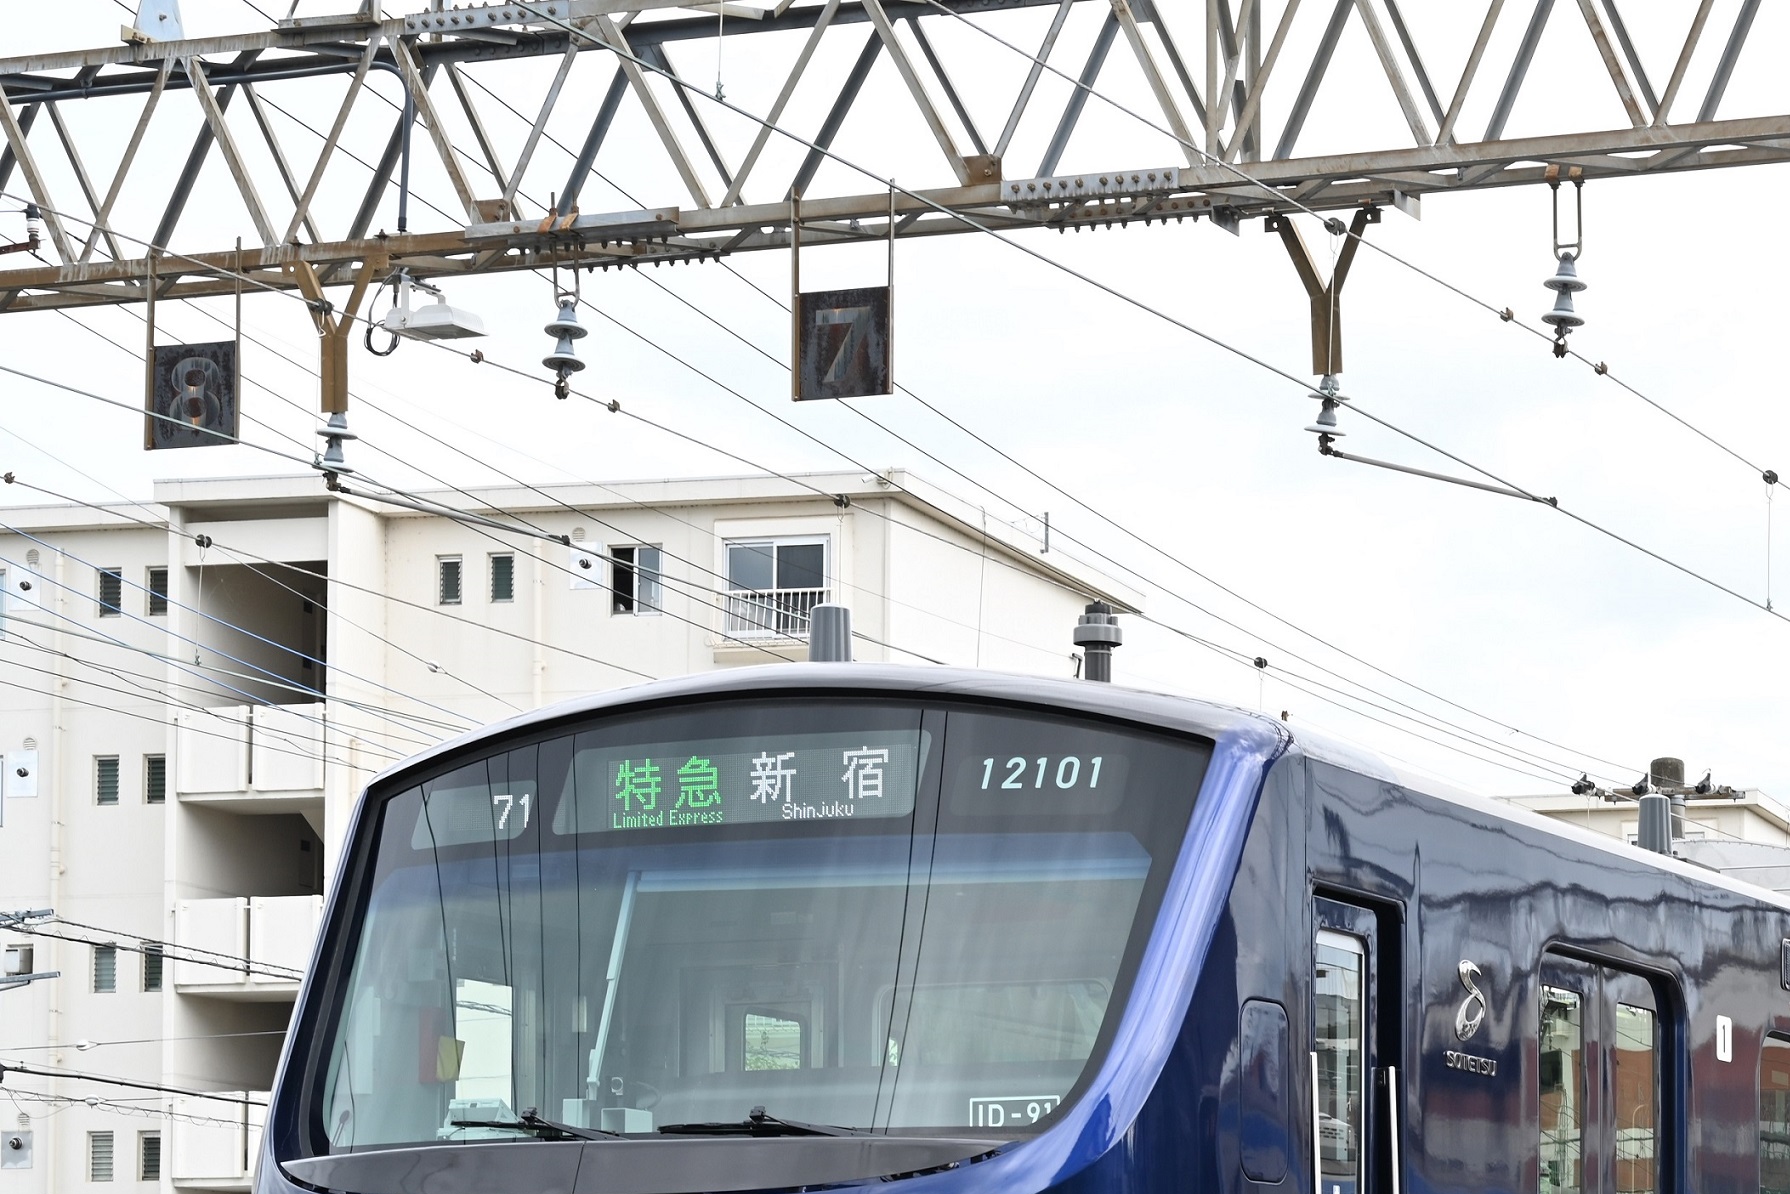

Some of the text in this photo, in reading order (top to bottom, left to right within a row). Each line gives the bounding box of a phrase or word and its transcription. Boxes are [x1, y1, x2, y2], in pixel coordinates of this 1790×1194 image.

[815, 306, 871, 382] 7
[170, 357, 220, 430] 8
[615, 746, 889, 810] 特急 新宿
[981, 756, 1102, 789] 12101
[493, 794, 529, 830] 71
[613, 810, 723, 829] Limited Express
[782, 801, 854, 819] Shinjuku
[1446, 1051, 1497, 1077] SOTETSU
